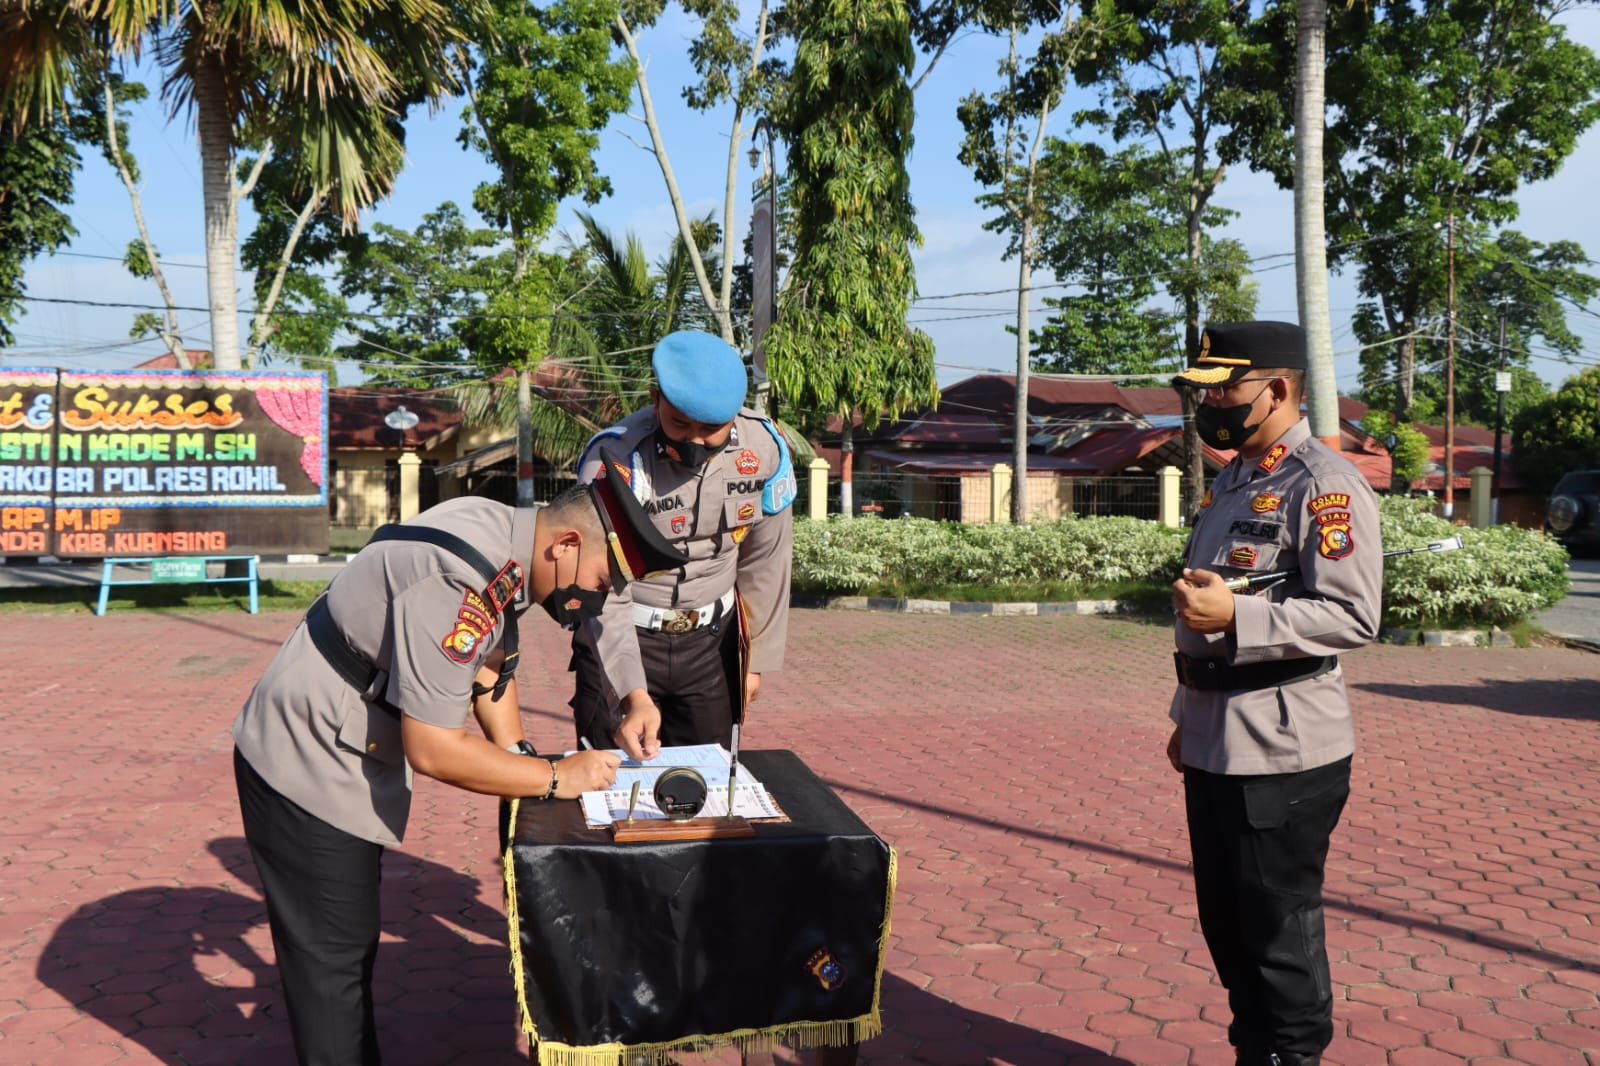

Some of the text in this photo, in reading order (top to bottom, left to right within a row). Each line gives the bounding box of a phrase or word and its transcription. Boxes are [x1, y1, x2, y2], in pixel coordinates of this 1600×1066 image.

[62, 387, 243, 430] Sukses
[88, 433, 171, 462] KADE
[103, 466, 207, 492] POLRES
[211, 467, 286, 492] ROHIL
[1228, 520, 1281, 539] POLRI
[1320, 513, 1348, 522] RIAU
